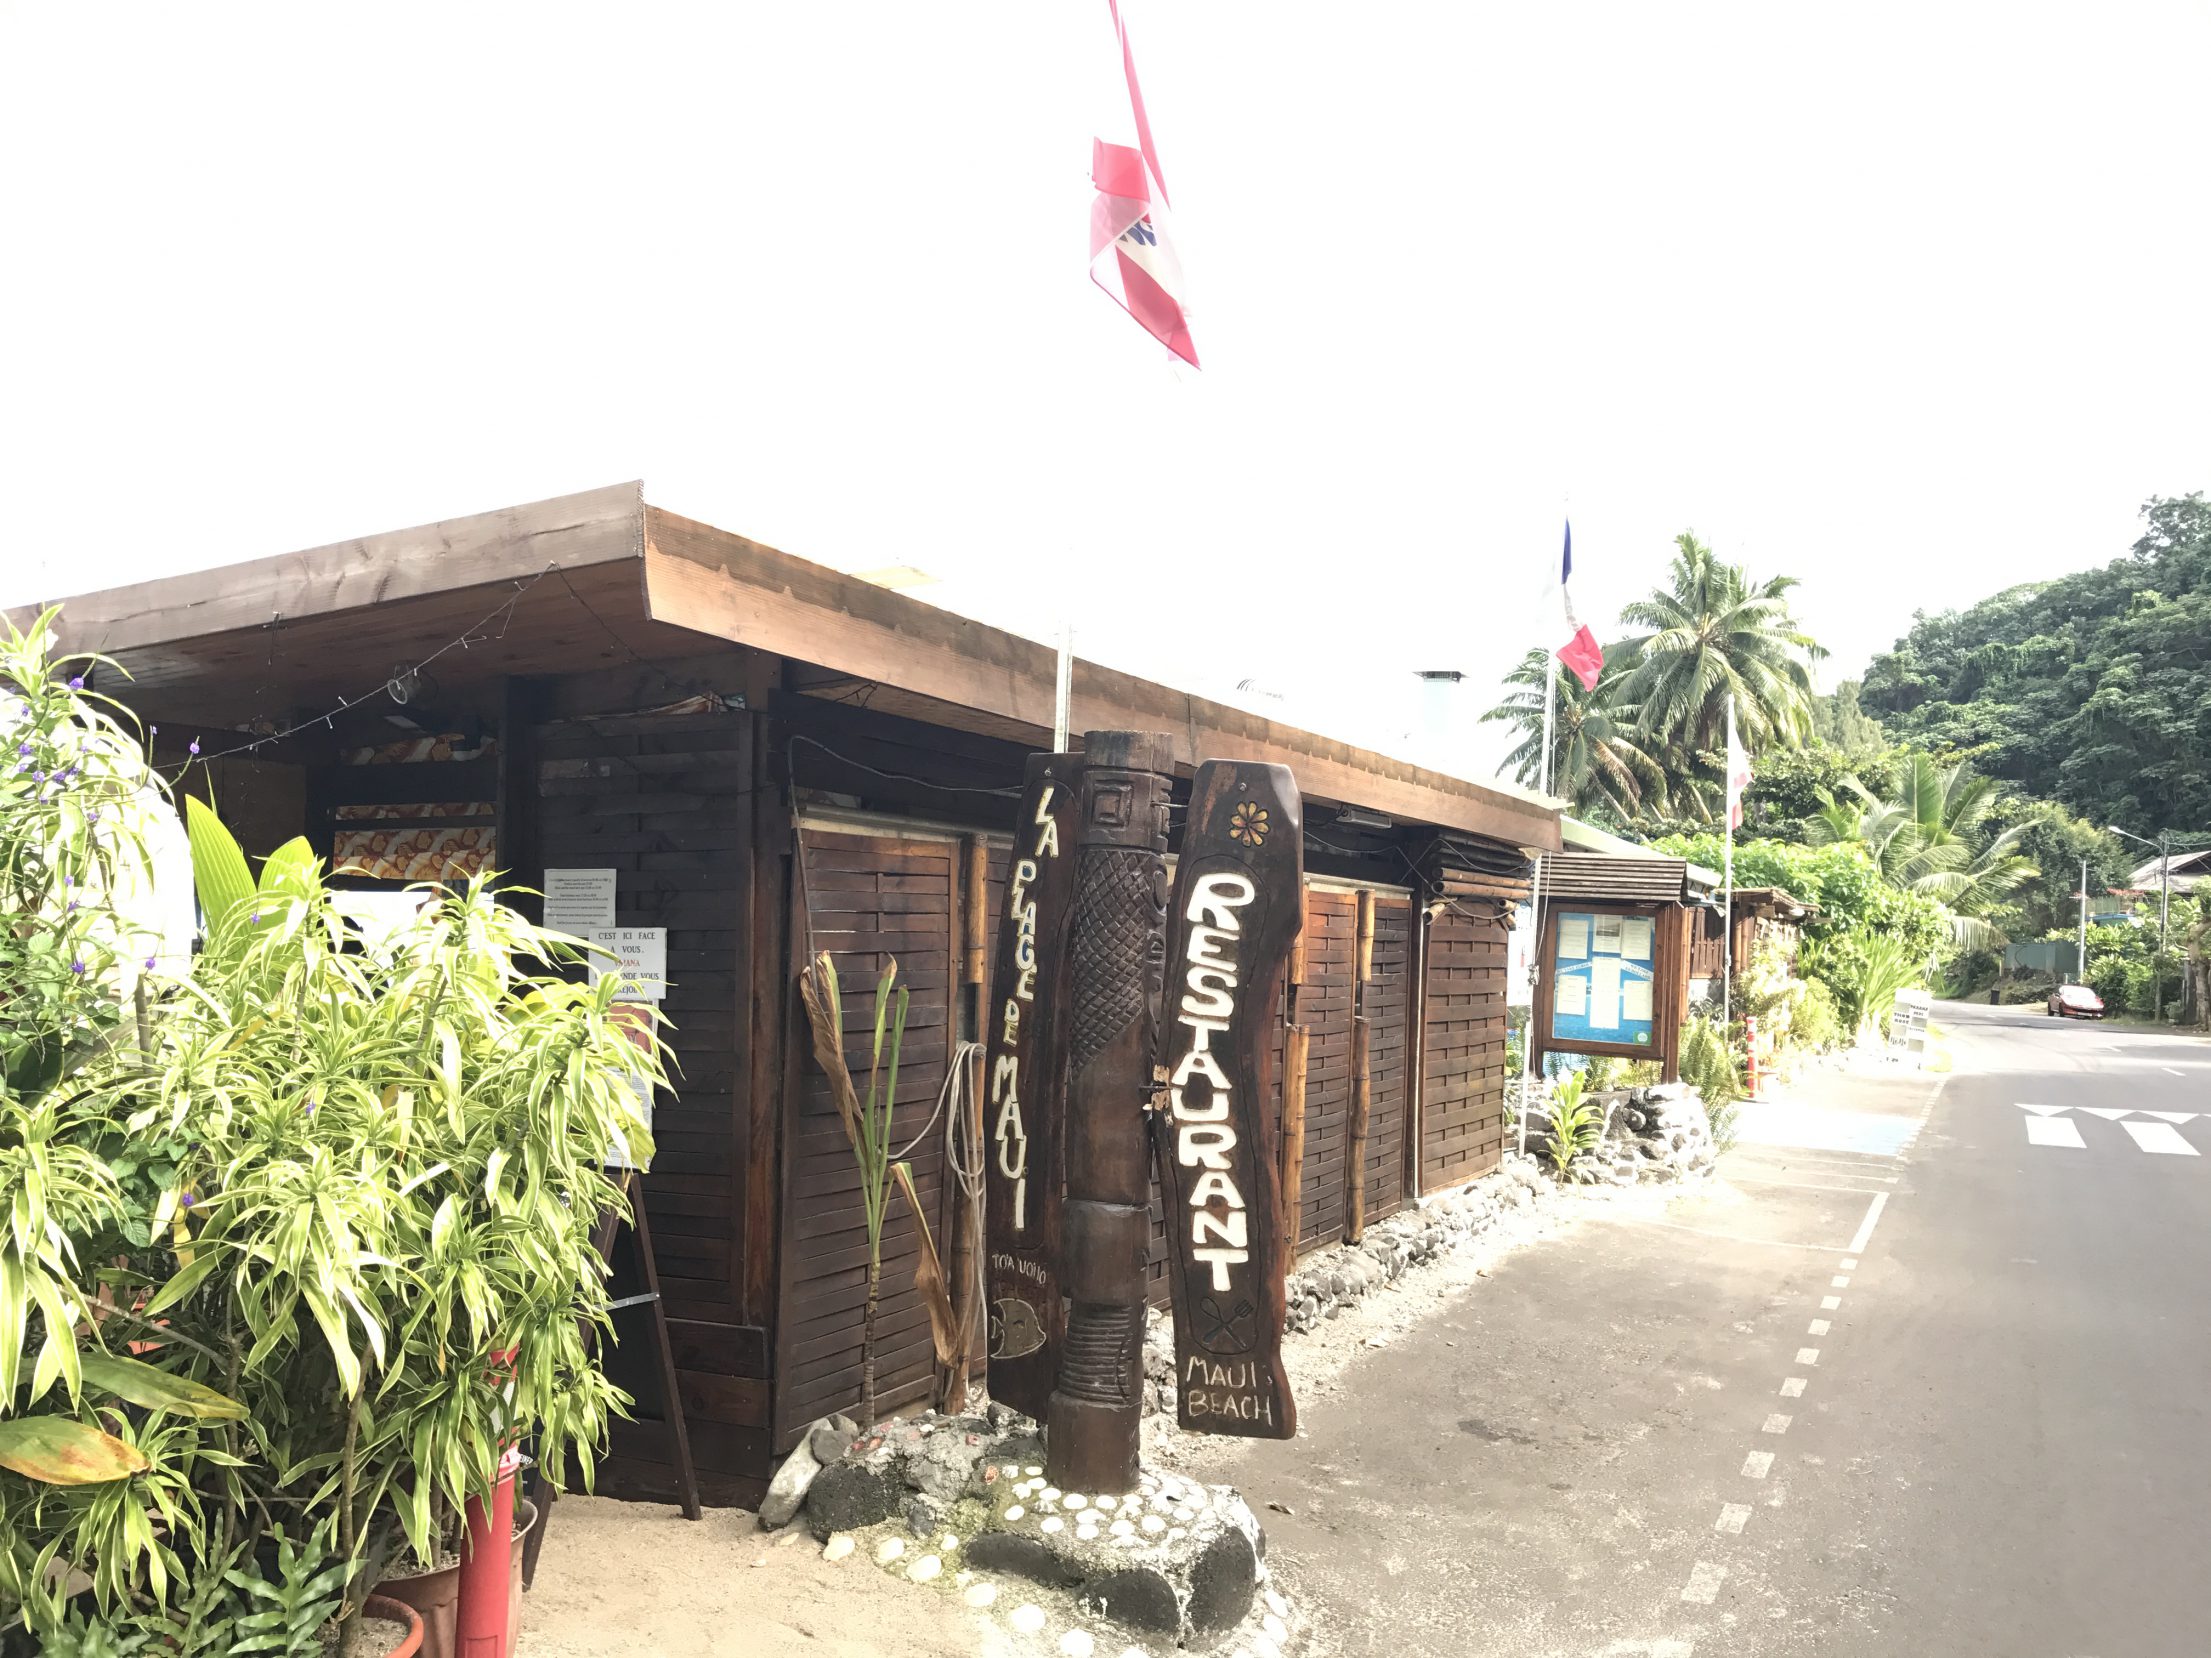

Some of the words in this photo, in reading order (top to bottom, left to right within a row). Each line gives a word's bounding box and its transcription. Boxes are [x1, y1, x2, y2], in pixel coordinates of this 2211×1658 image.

[1035, 786, 1060, 858] LA
[623, 932, 632, 940] ICI
[638, 932, 656, 940] FACE
[1011, 859, 1038, 1001] PLAGE
[1002, 998, 1019, 1046] DE
[1171, 872, 1256, 1292] RESTAURANT
[992, 1054, 1028, 1230] MAUI
[1186, 1356, 1257, 1389] MAUI
[1188, 1389, 1273, 1427] BEACH
